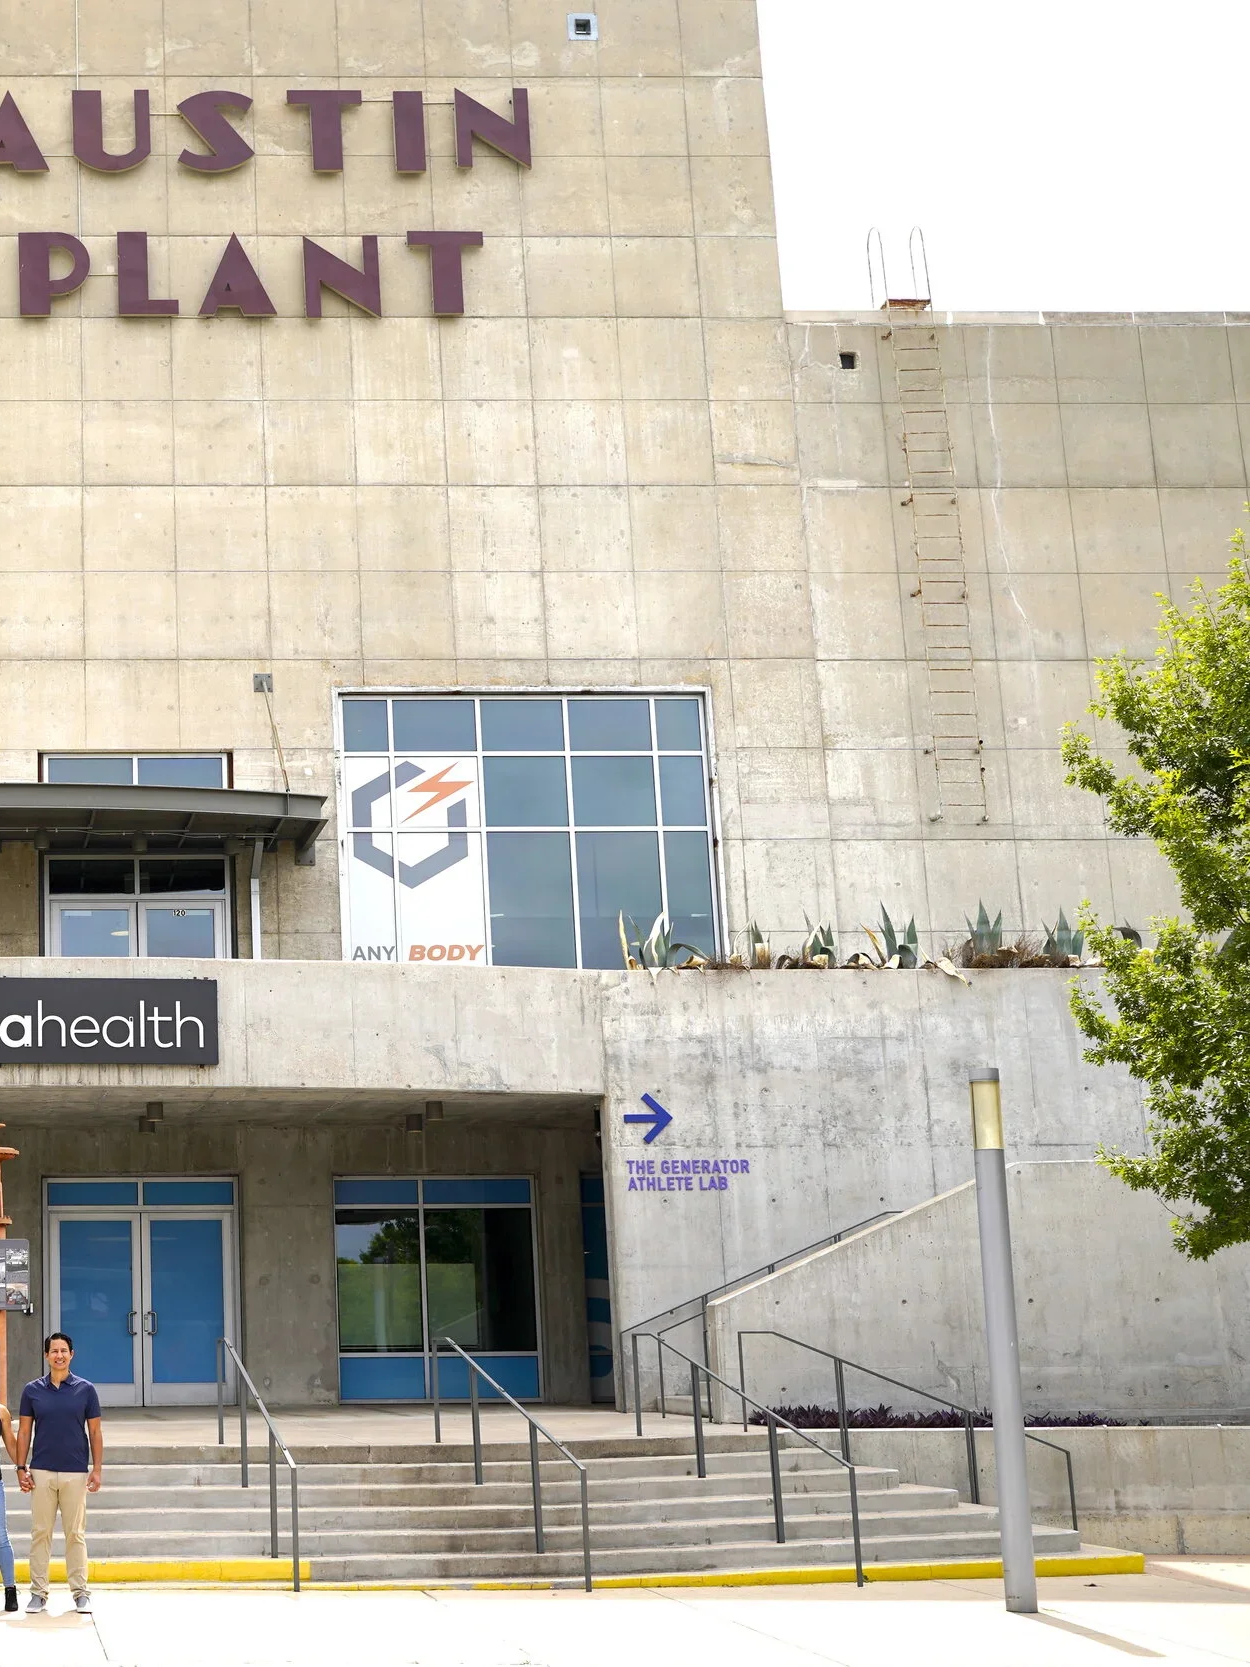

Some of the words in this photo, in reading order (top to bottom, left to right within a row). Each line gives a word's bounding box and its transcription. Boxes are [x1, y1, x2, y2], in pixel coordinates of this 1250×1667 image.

[18, 230, 484, 319] PLANT
[172, 909, 187, 917] 120
[352, 945, 396, 961] ANY
[408, 944, 485, 961] BODY
[626, 1160, 656, 1175] THE
[660, 1159, 750, 1174] GENERATOR
[628, 1176, 694, 1191] ATHLETE
[699, 1176, 729, 1191] LAB
